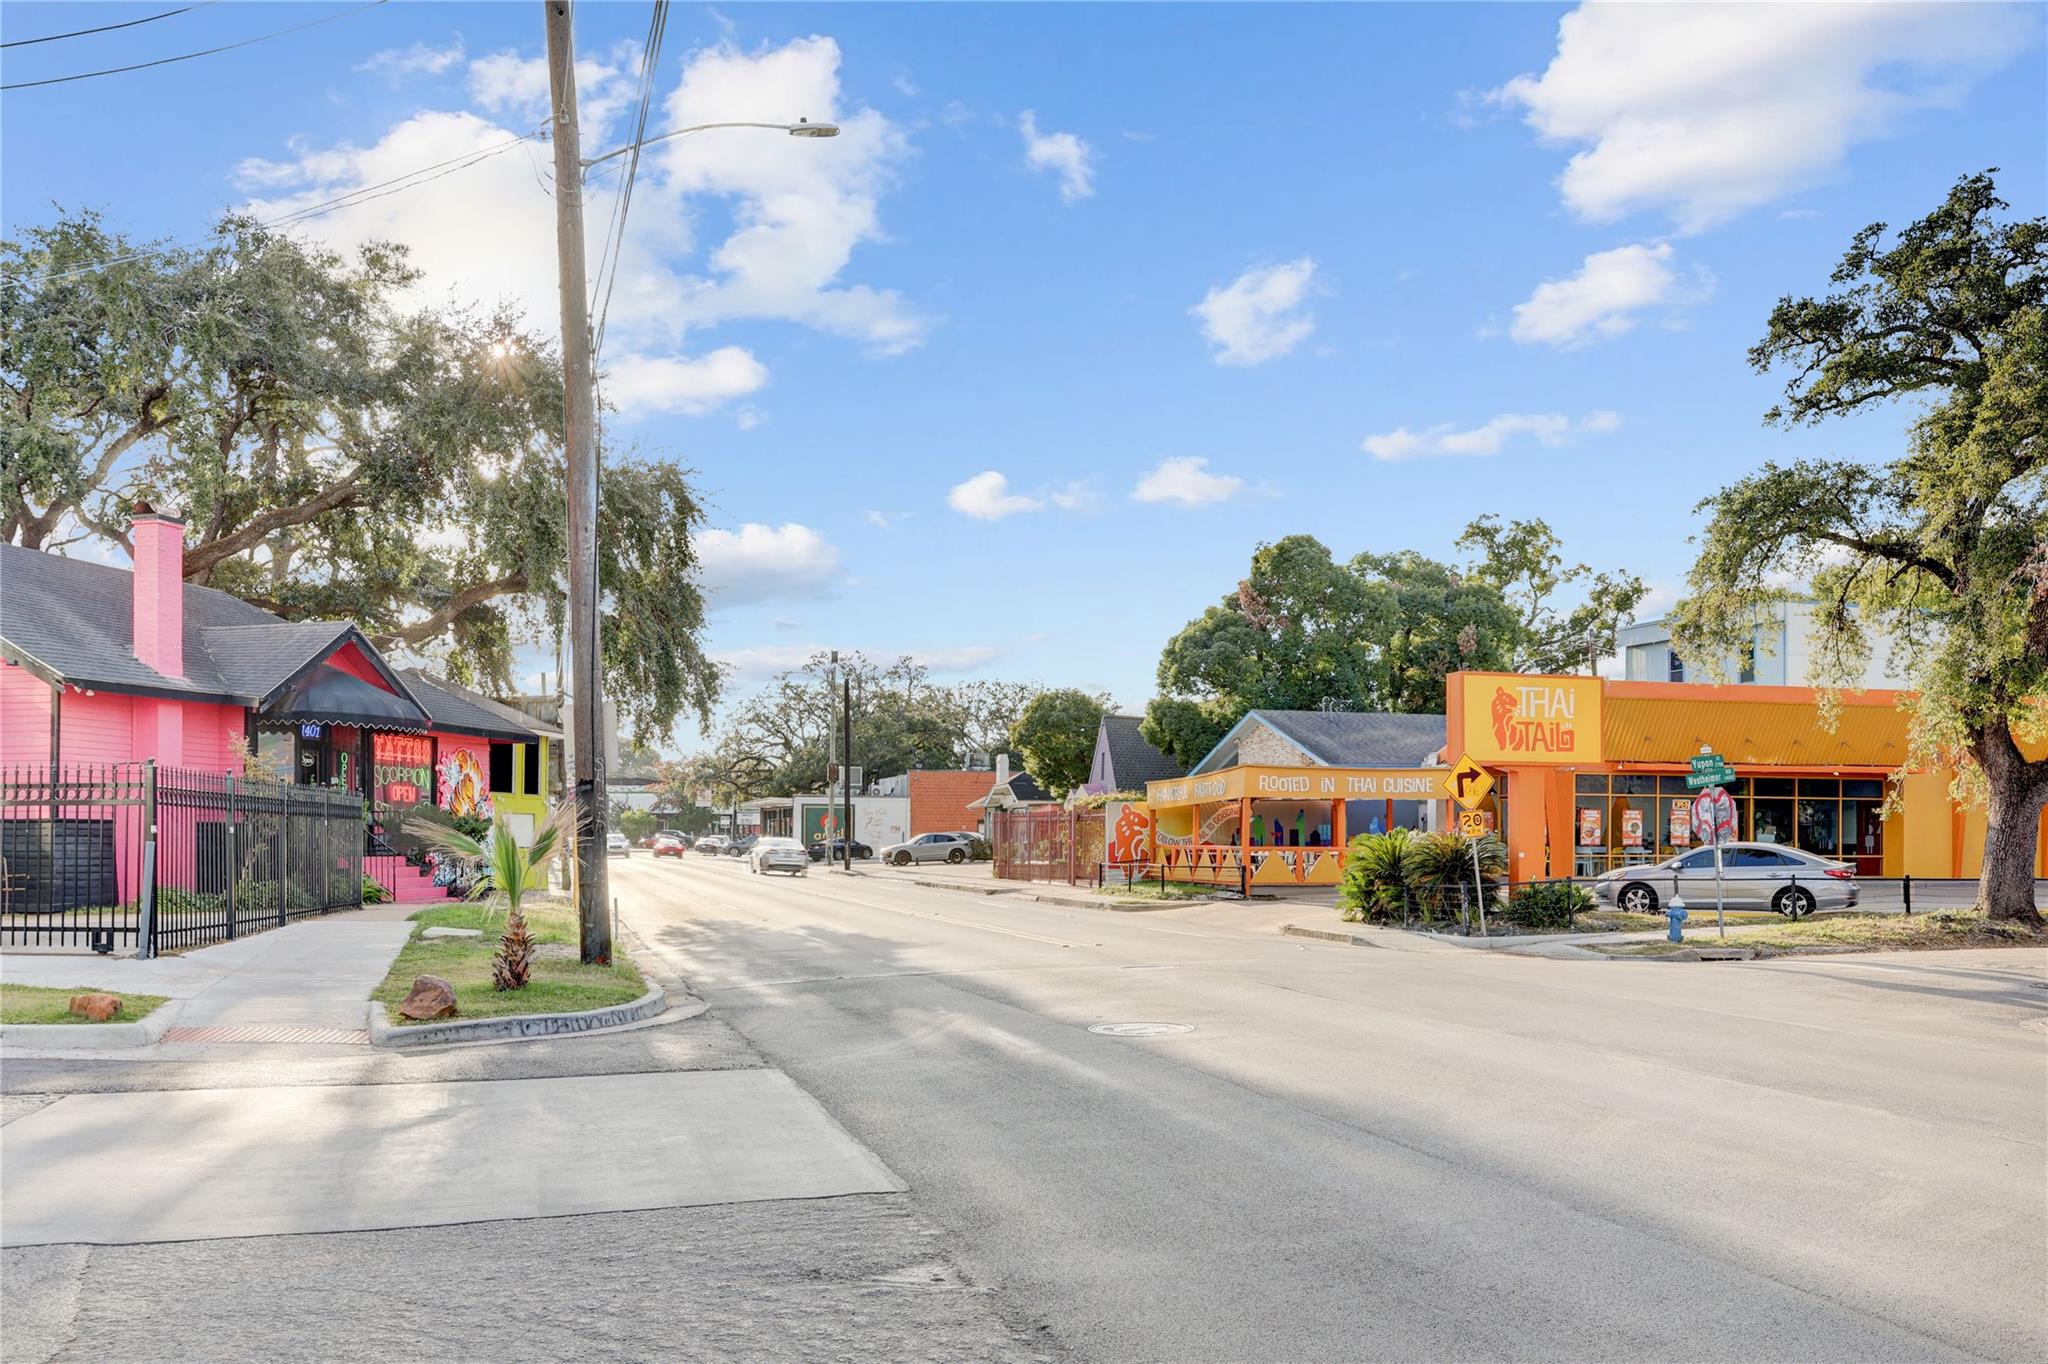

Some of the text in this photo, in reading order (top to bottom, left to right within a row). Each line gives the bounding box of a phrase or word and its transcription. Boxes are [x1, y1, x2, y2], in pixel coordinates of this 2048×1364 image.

[301, 724, 320, 738] 1401
[374, 734, 431, 763] TATTOO
[374, 766, 430, 789] SCORPION
[1259, 775, 1310, 792] ROOTED
[1688, 774, 1721, 785] Westheimer
[393, 785, 416, 801] OPEN
[1462, 813, 1482, 826] 20
